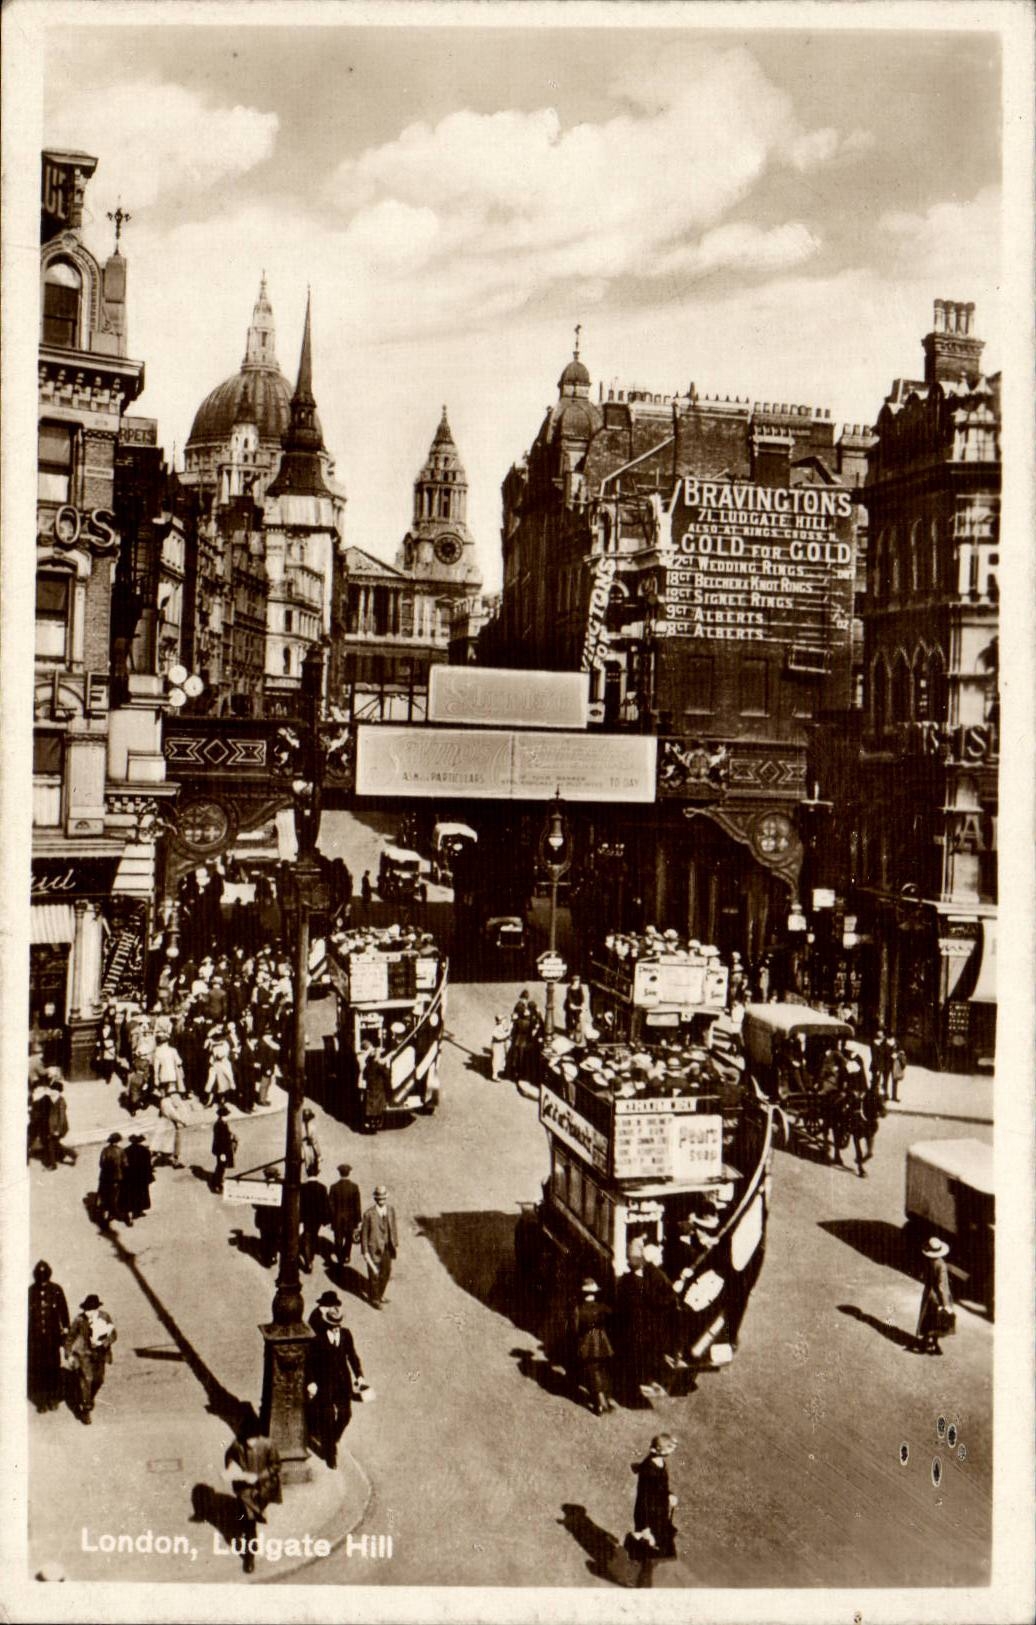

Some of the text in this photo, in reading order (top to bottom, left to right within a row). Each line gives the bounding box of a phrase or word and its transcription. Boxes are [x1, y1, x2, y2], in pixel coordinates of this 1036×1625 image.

[684, 476, 852, 517] BRAVINGTONS
[720, 510, 788, 528] LUDGATE
[682, 533, 850, 564] GOLD FOR GOLD
[698, 557, 757, 573] WEDDING
[762, 560, 804, 576] RINGS
[694, 607, 764, 625] ALBERTS
[694, 622, 764, 641] ALBERTS
